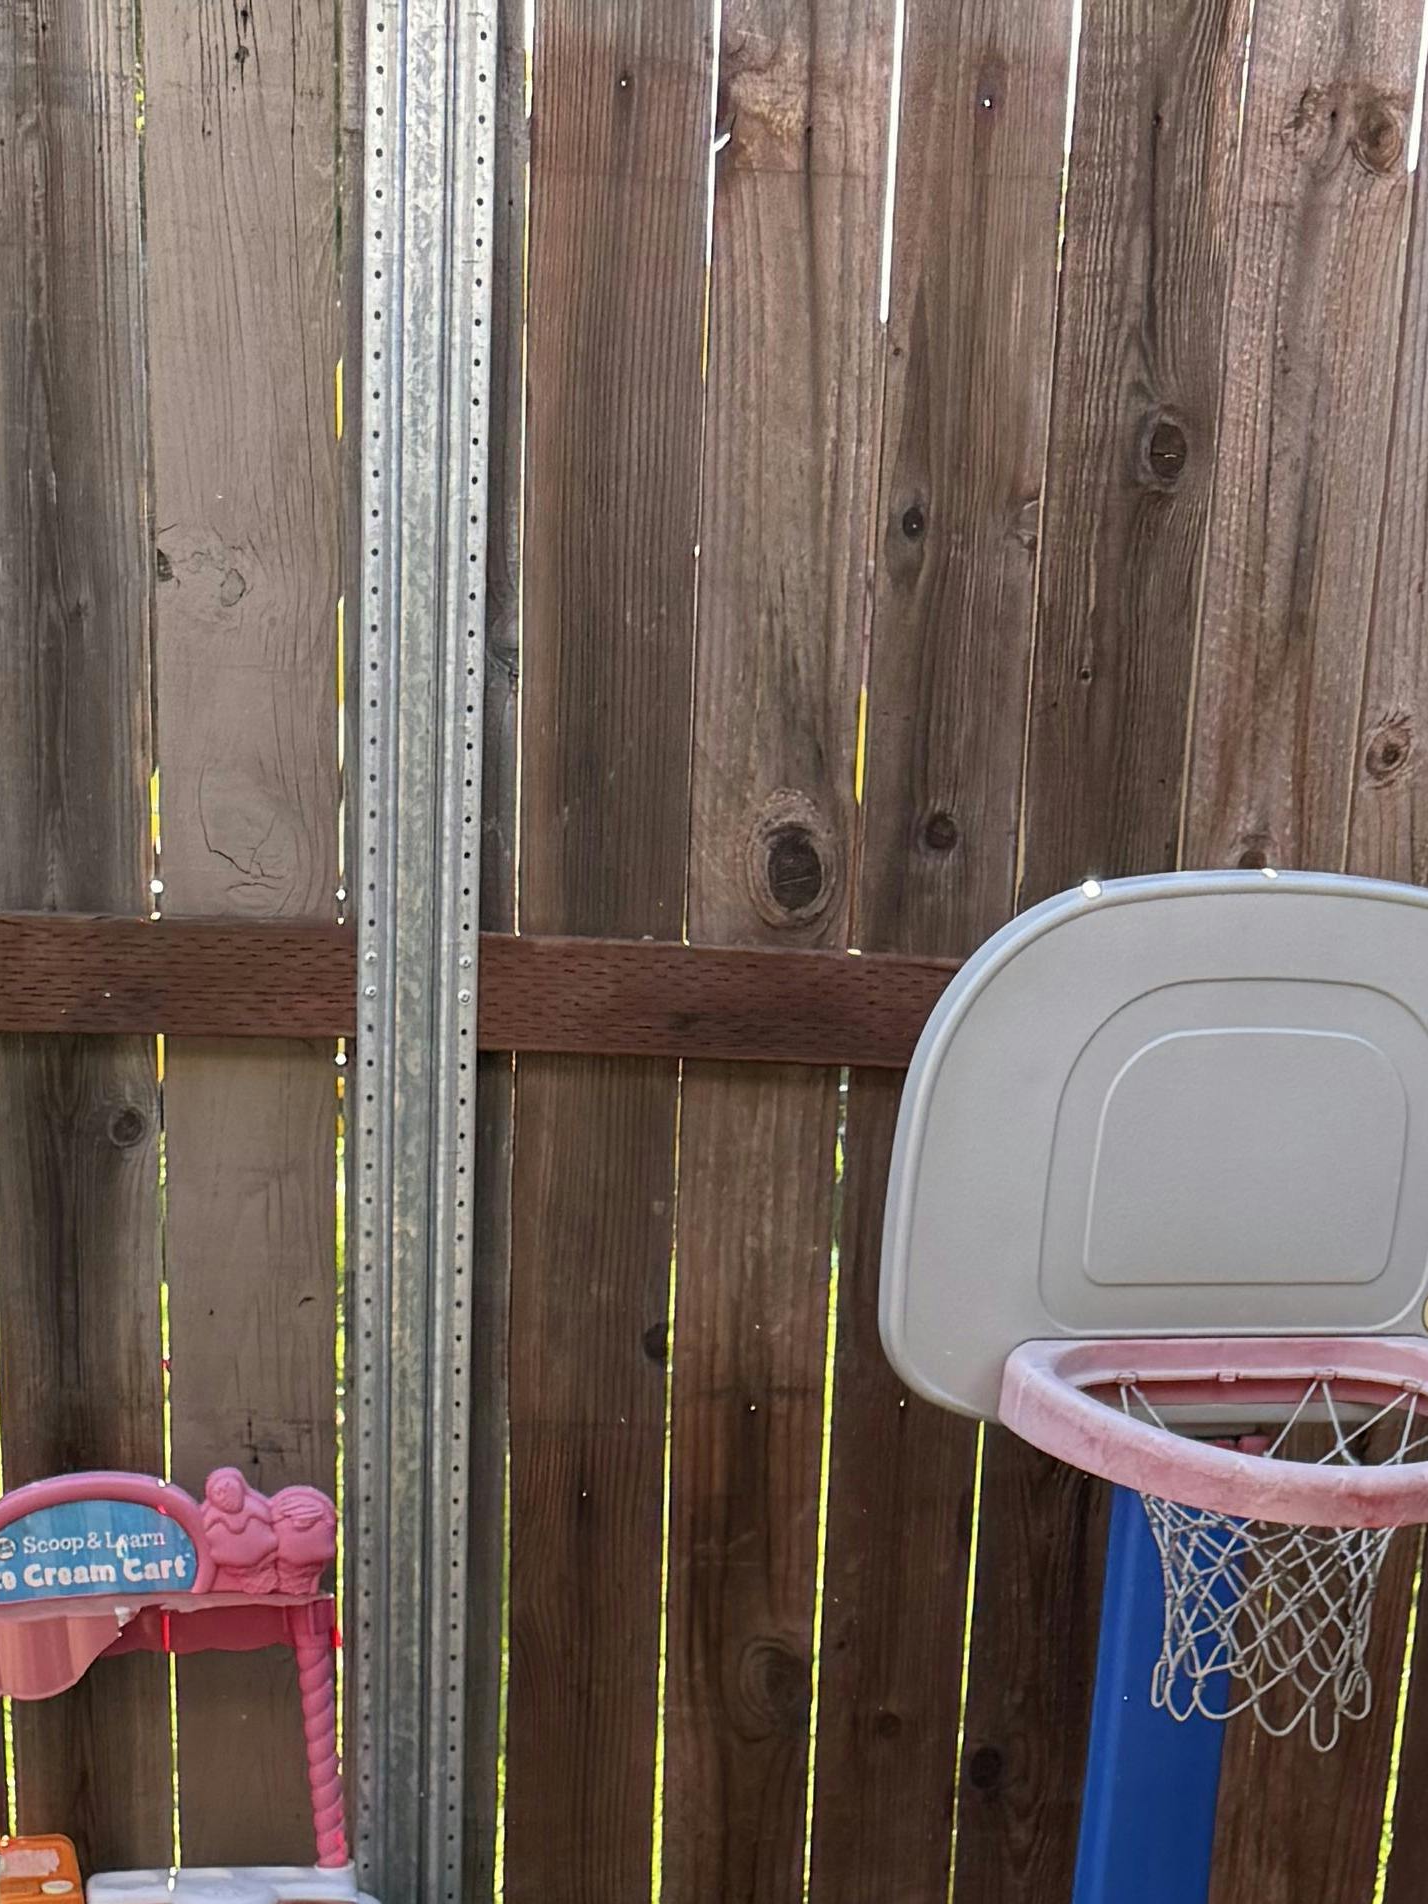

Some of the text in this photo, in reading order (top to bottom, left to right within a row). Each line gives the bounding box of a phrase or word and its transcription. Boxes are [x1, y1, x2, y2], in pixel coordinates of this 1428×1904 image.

[23, 1535, 84, 1556] Scoop
[87, 1531, 102, 1549] &
[105, 1530, 165, 1550] Learn
[23, 1562, 117, 1588] Cream
[123, 1553, 186, 1583] Cart
